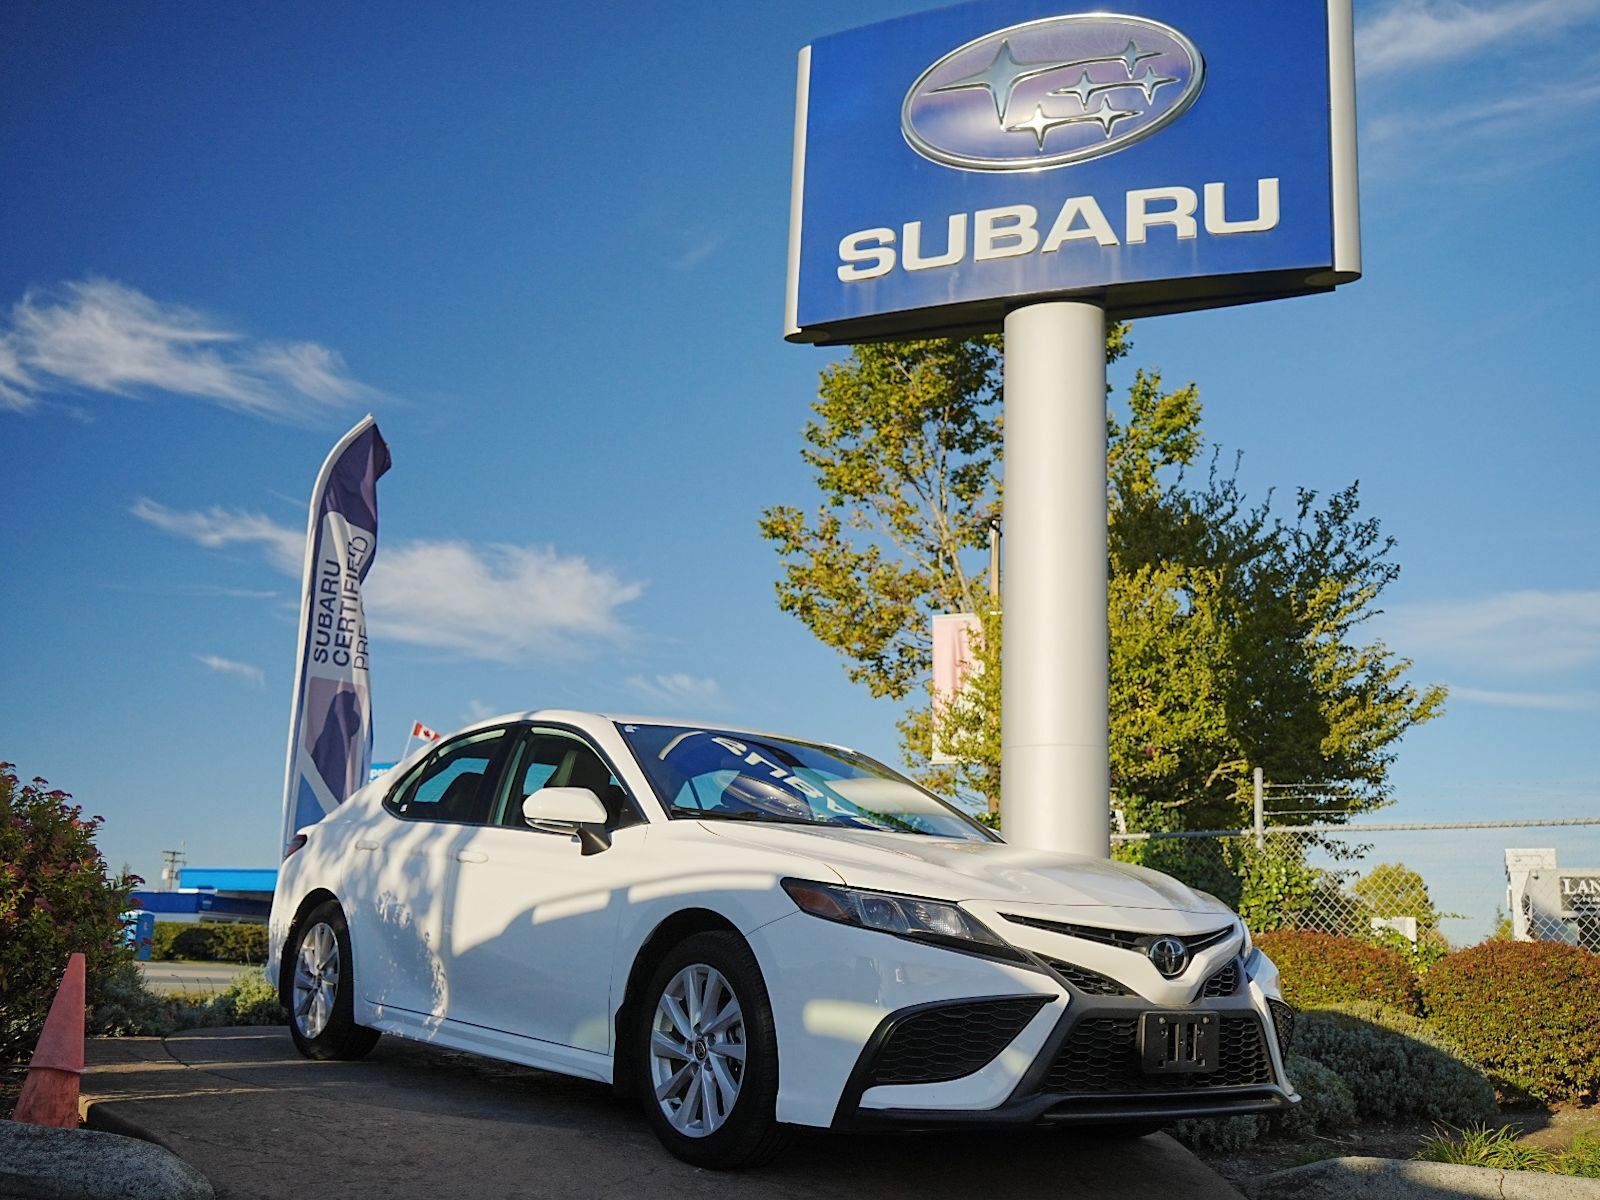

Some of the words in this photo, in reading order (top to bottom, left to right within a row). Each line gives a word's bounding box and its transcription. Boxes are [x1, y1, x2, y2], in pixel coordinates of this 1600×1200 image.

[837, 178, 1280, 283] SUBARU
[313, 559, 342, 665] SUBARU
[332, 536, 368, 667] CERTIFIED
[353, 602, 369, 671] PRE
